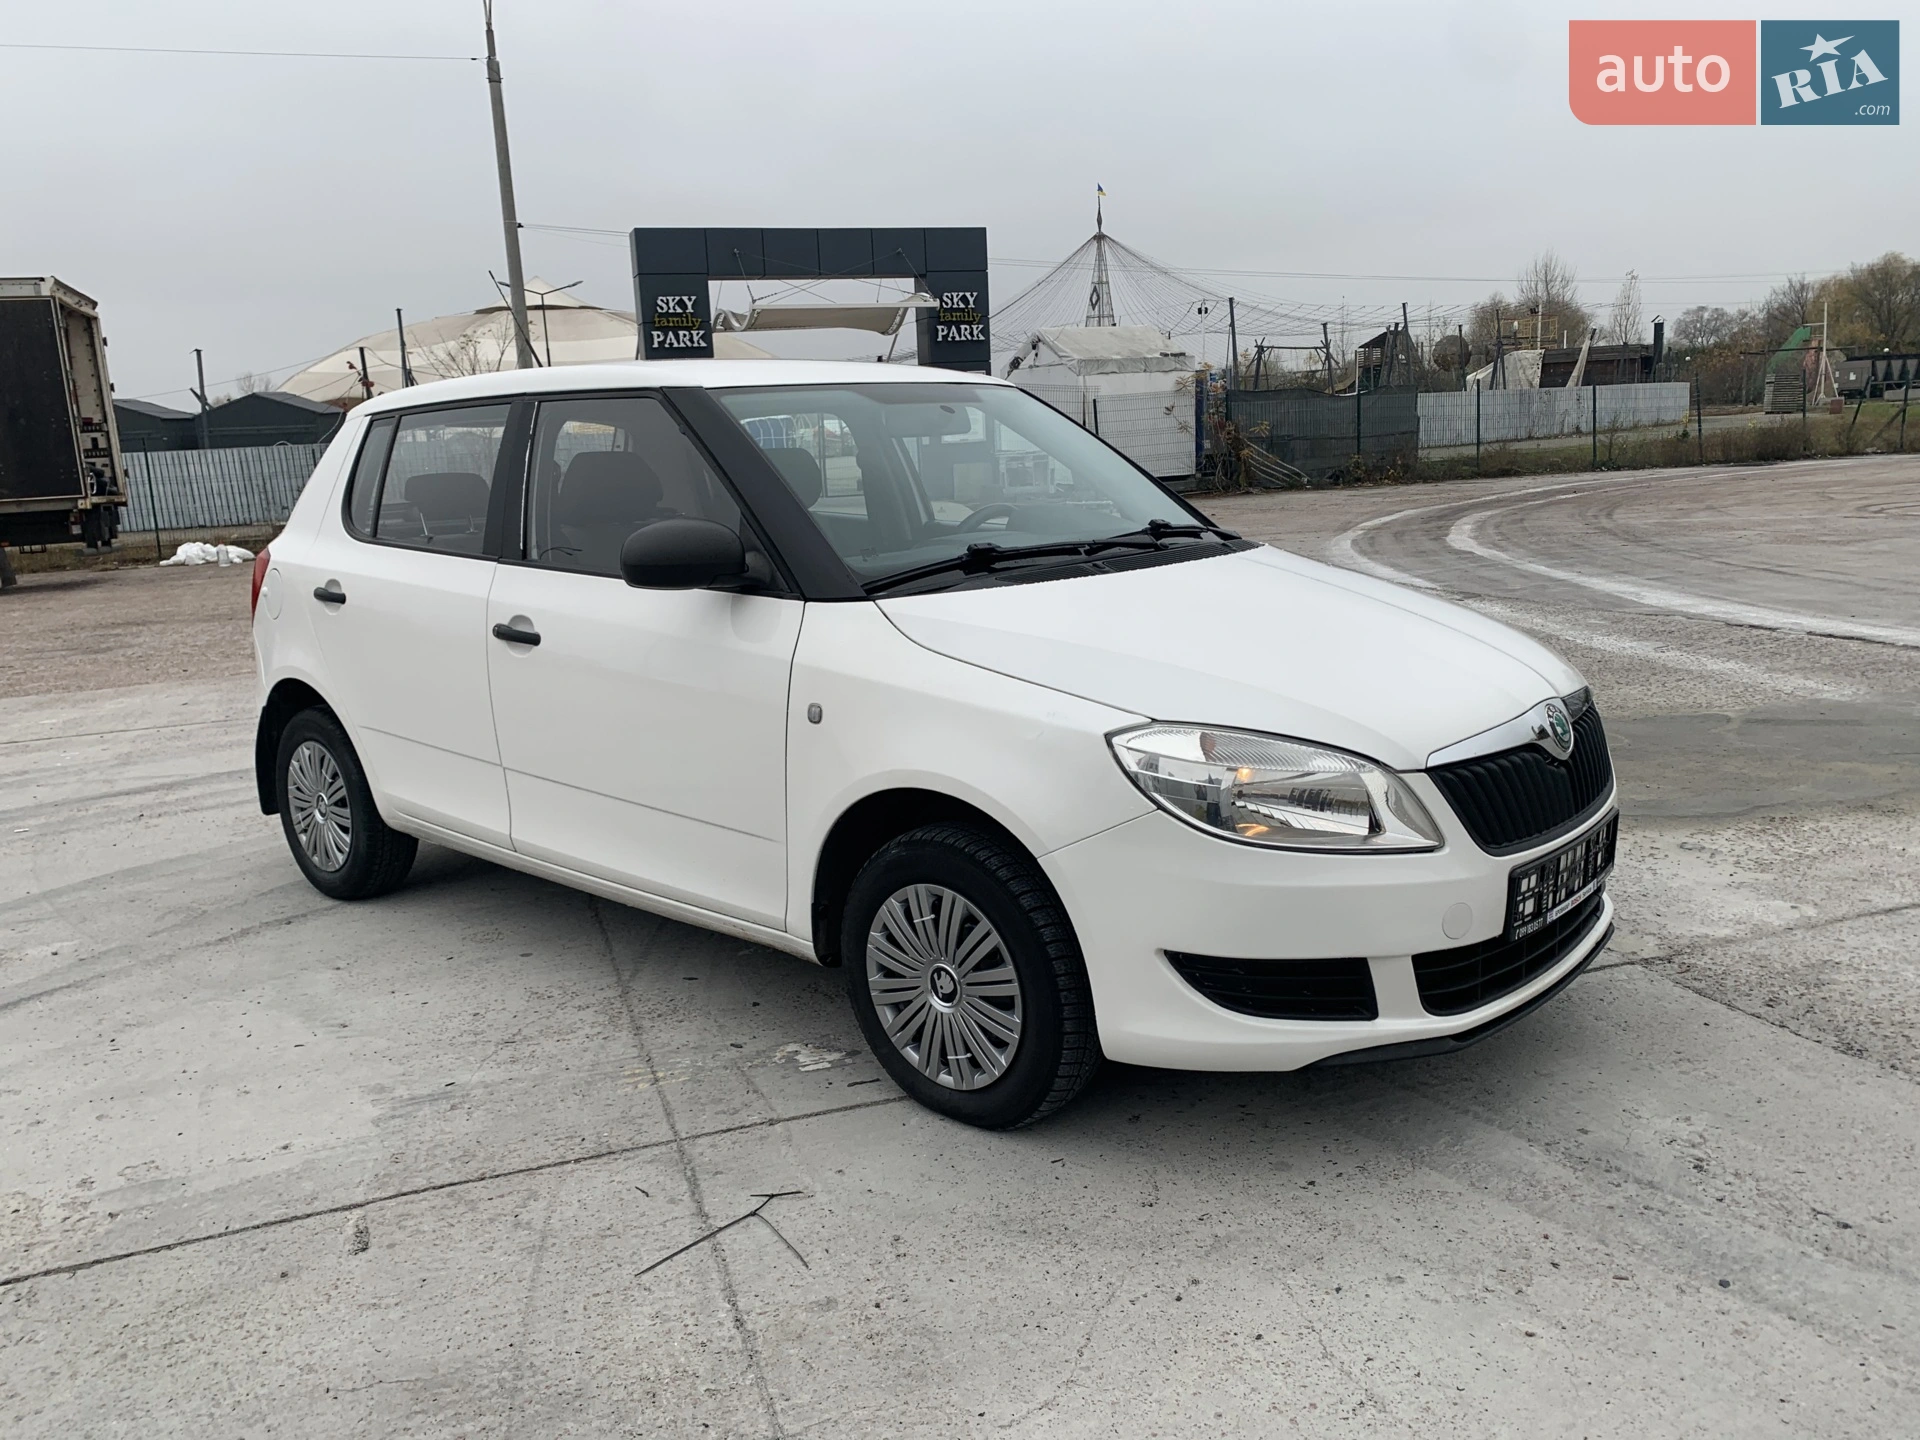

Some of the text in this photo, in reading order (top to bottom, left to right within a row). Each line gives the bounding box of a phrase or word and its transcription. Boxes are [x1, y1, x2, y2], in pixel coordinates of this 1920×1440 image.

[656, 295, 697, 313] SKY
[941, 291, 978, 309] SKY
[653, 312, 702, 330] family
[939, 308, 982, 324] family
[650, 330, 708, 348] PARK
[936, 324, 986, 342] PARK
